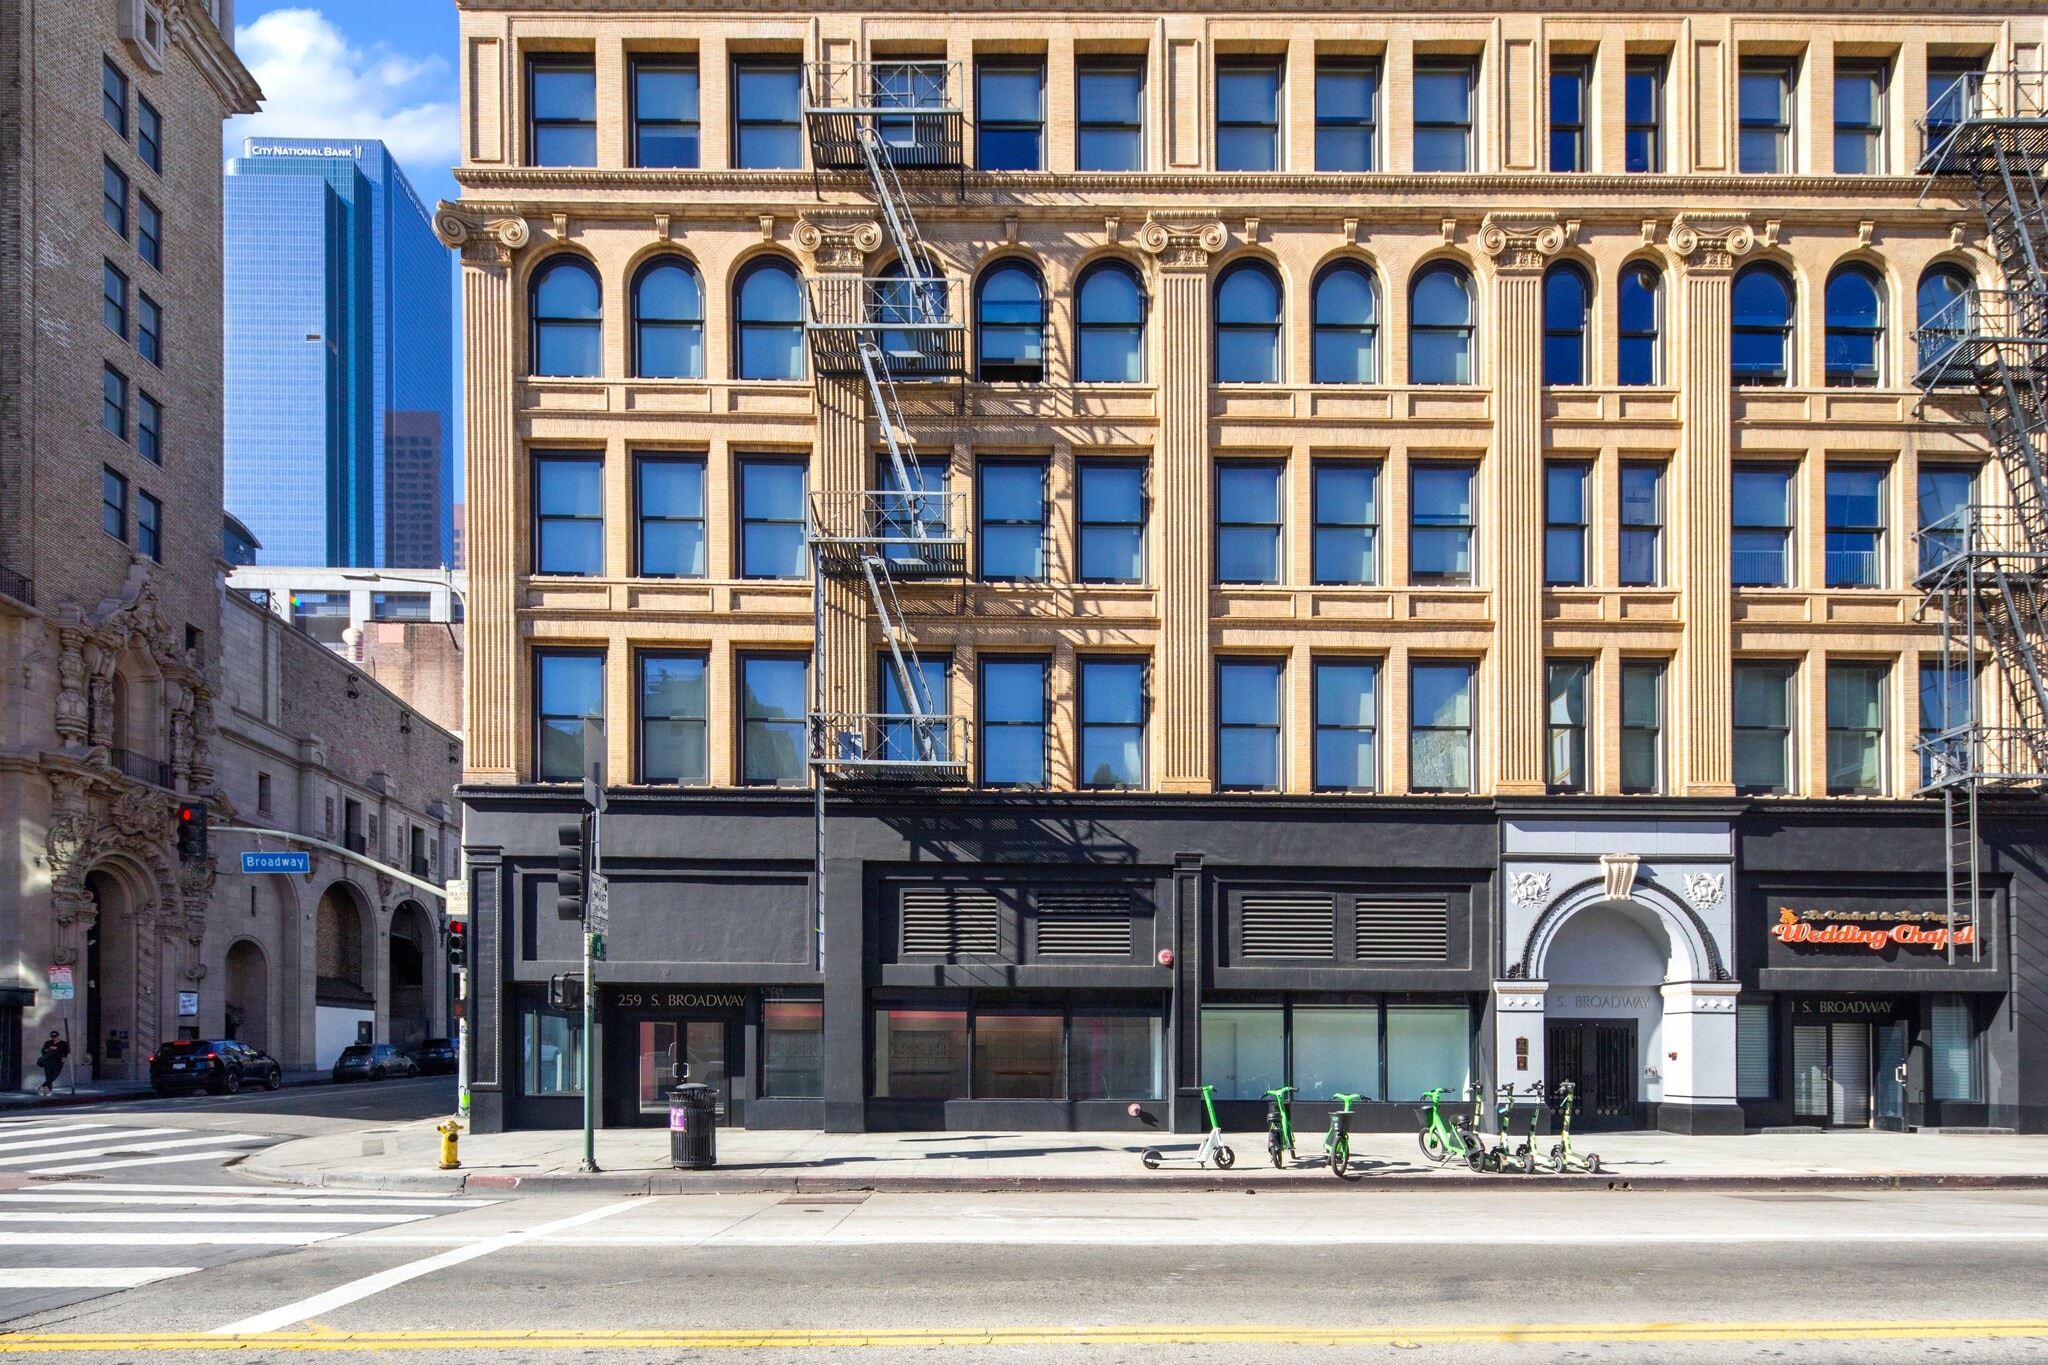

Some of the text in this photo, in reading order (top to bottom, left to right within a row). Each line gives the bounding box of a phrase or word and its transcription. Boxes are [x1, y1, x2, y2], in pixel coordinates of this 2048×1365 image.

[252, 145, 353, 157] CITY NATIONAL BANK
[246, 856, 304, 869] Broadway
[1772, 923, 1888, 949] Wedding
[617, 994, 746, 1007] 259 S. BROADWAY
[1575, 996, 1651, 1009] BROADWAY
[1802, 1001, 1812, 1013] S.
[1820, 1001, 1893, 1013] BROADWAY
